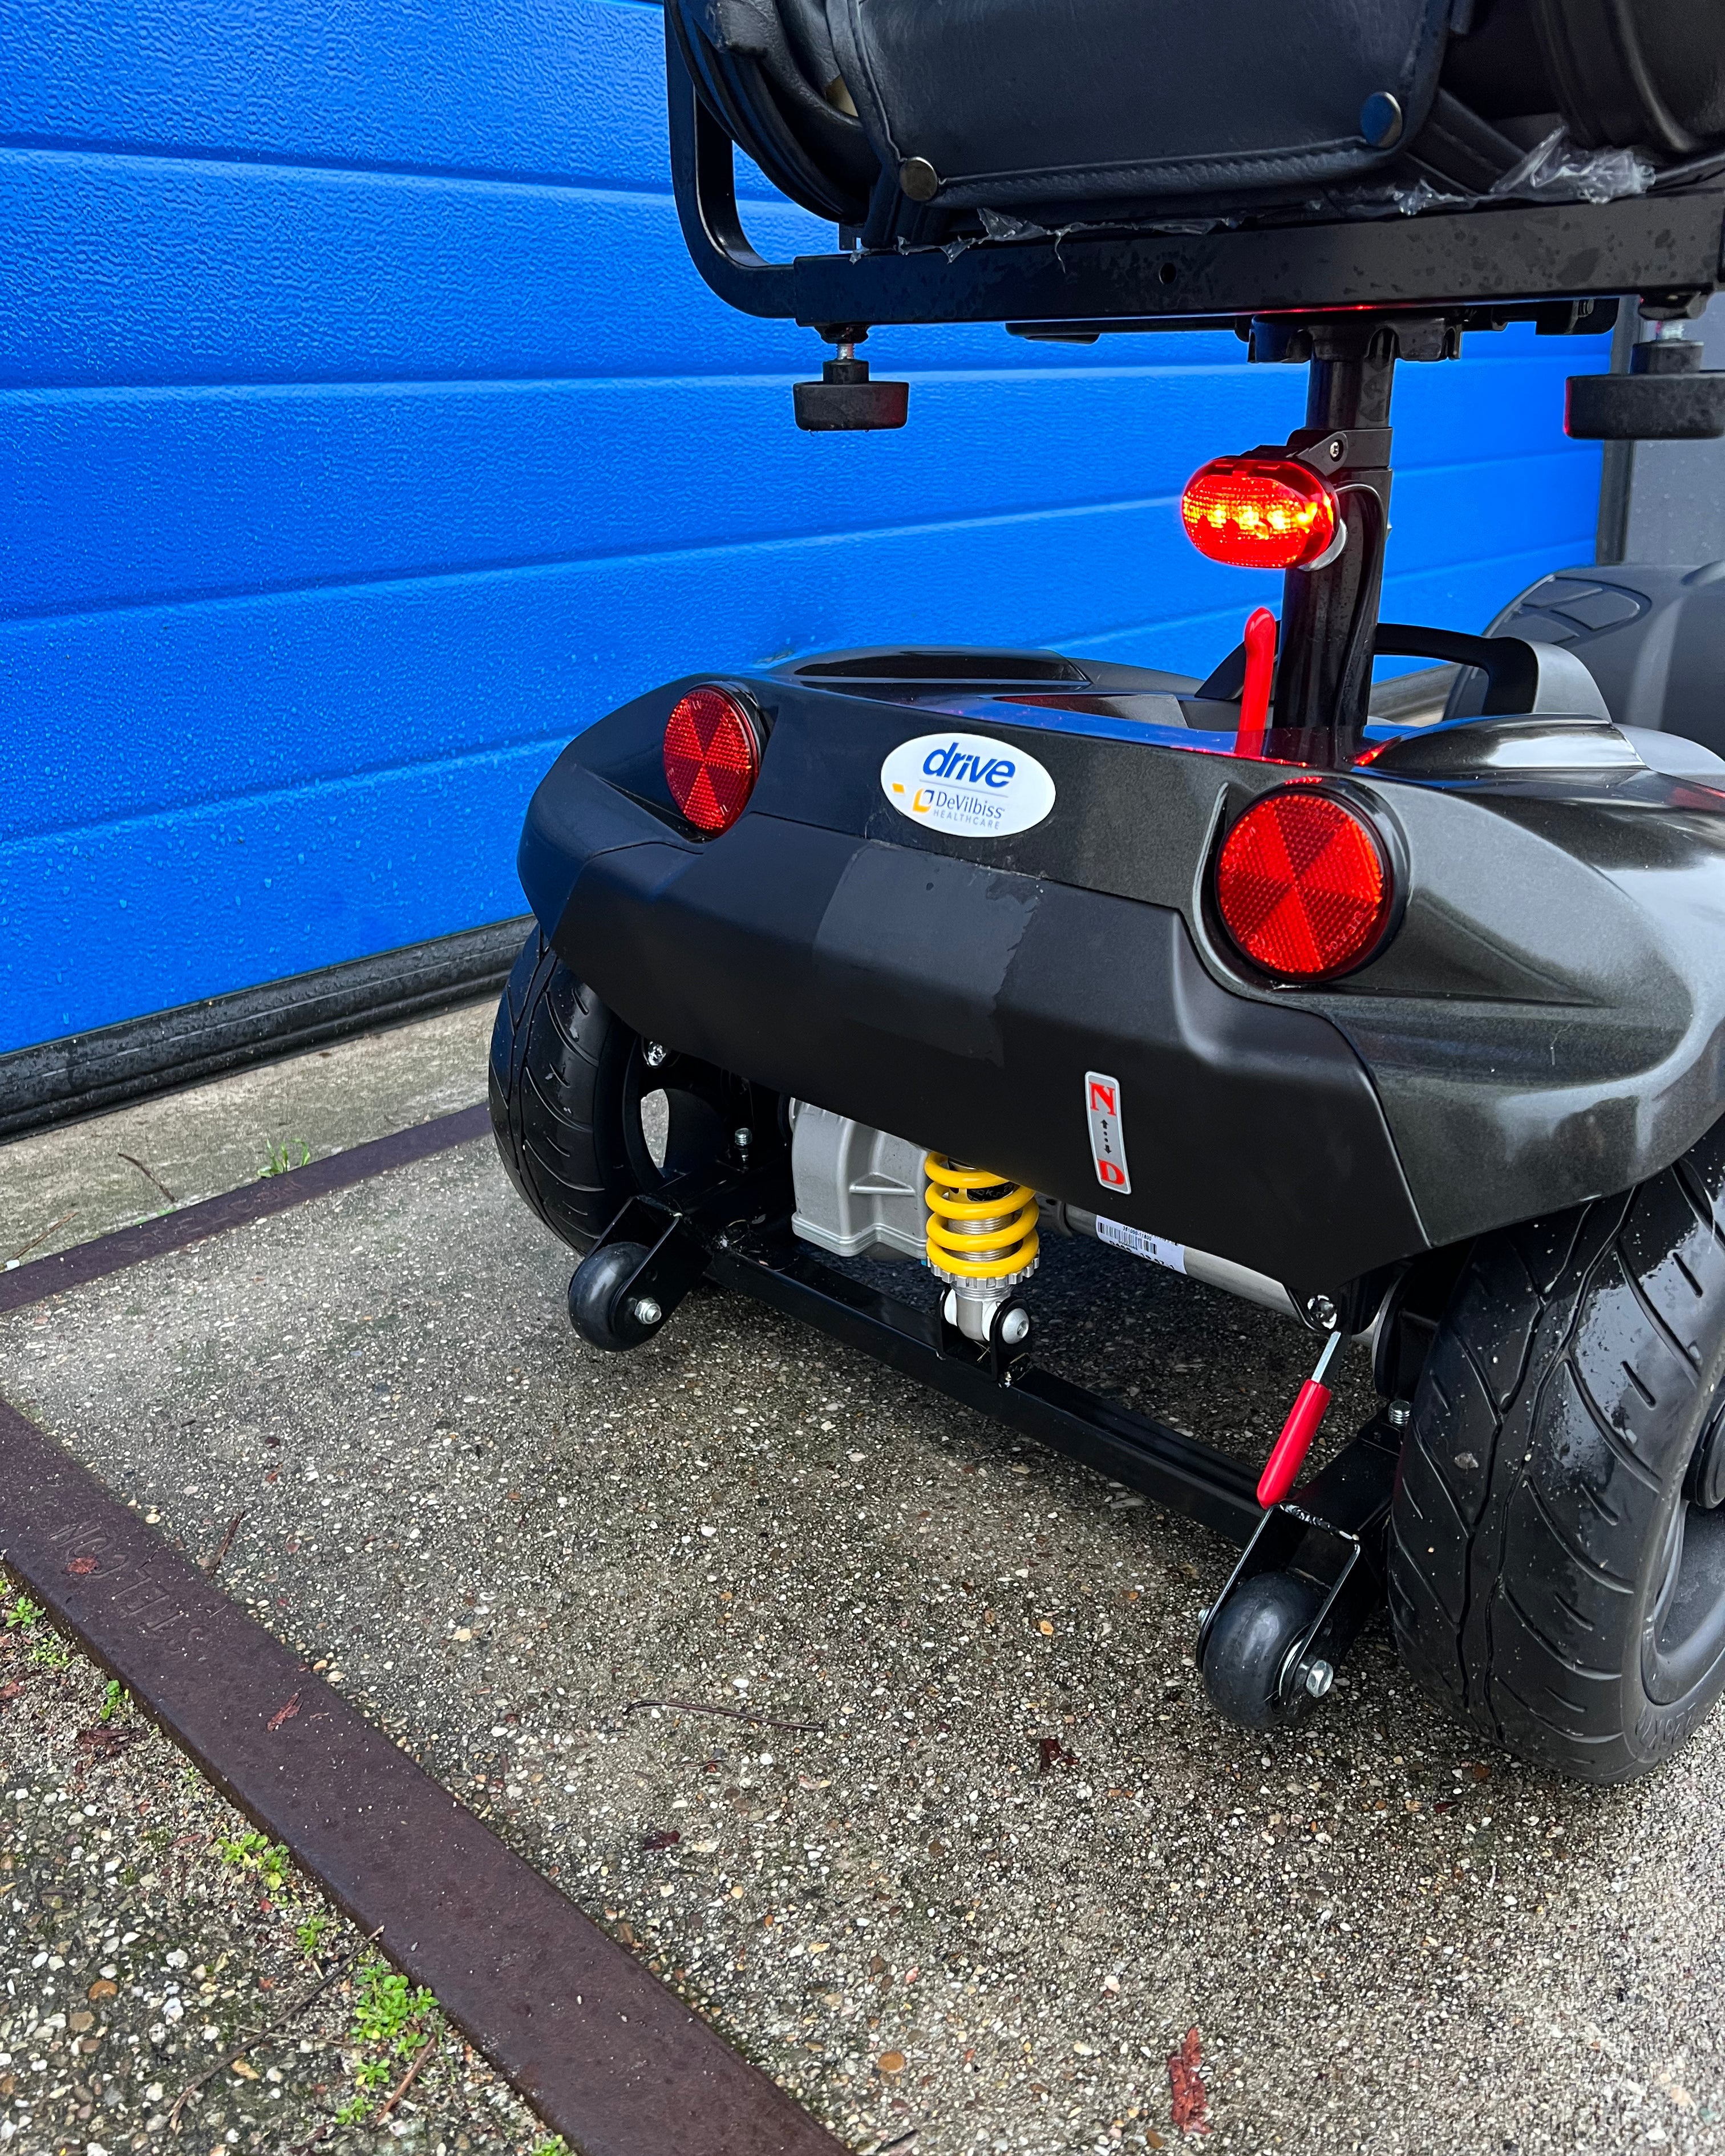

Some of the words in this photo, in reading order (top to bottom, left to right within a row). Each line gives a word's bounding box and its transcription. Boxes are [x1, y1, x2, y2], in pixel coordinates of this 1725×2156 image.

[923, 742, 1015, 788] drive
[936, 791, 1002, 819] DeVilbiss
[933, 809, 1000, 830] HEALTHCARE
[1090, 1081, 1117, 1116] N
[1097, 1158, 1125, 1185] D
